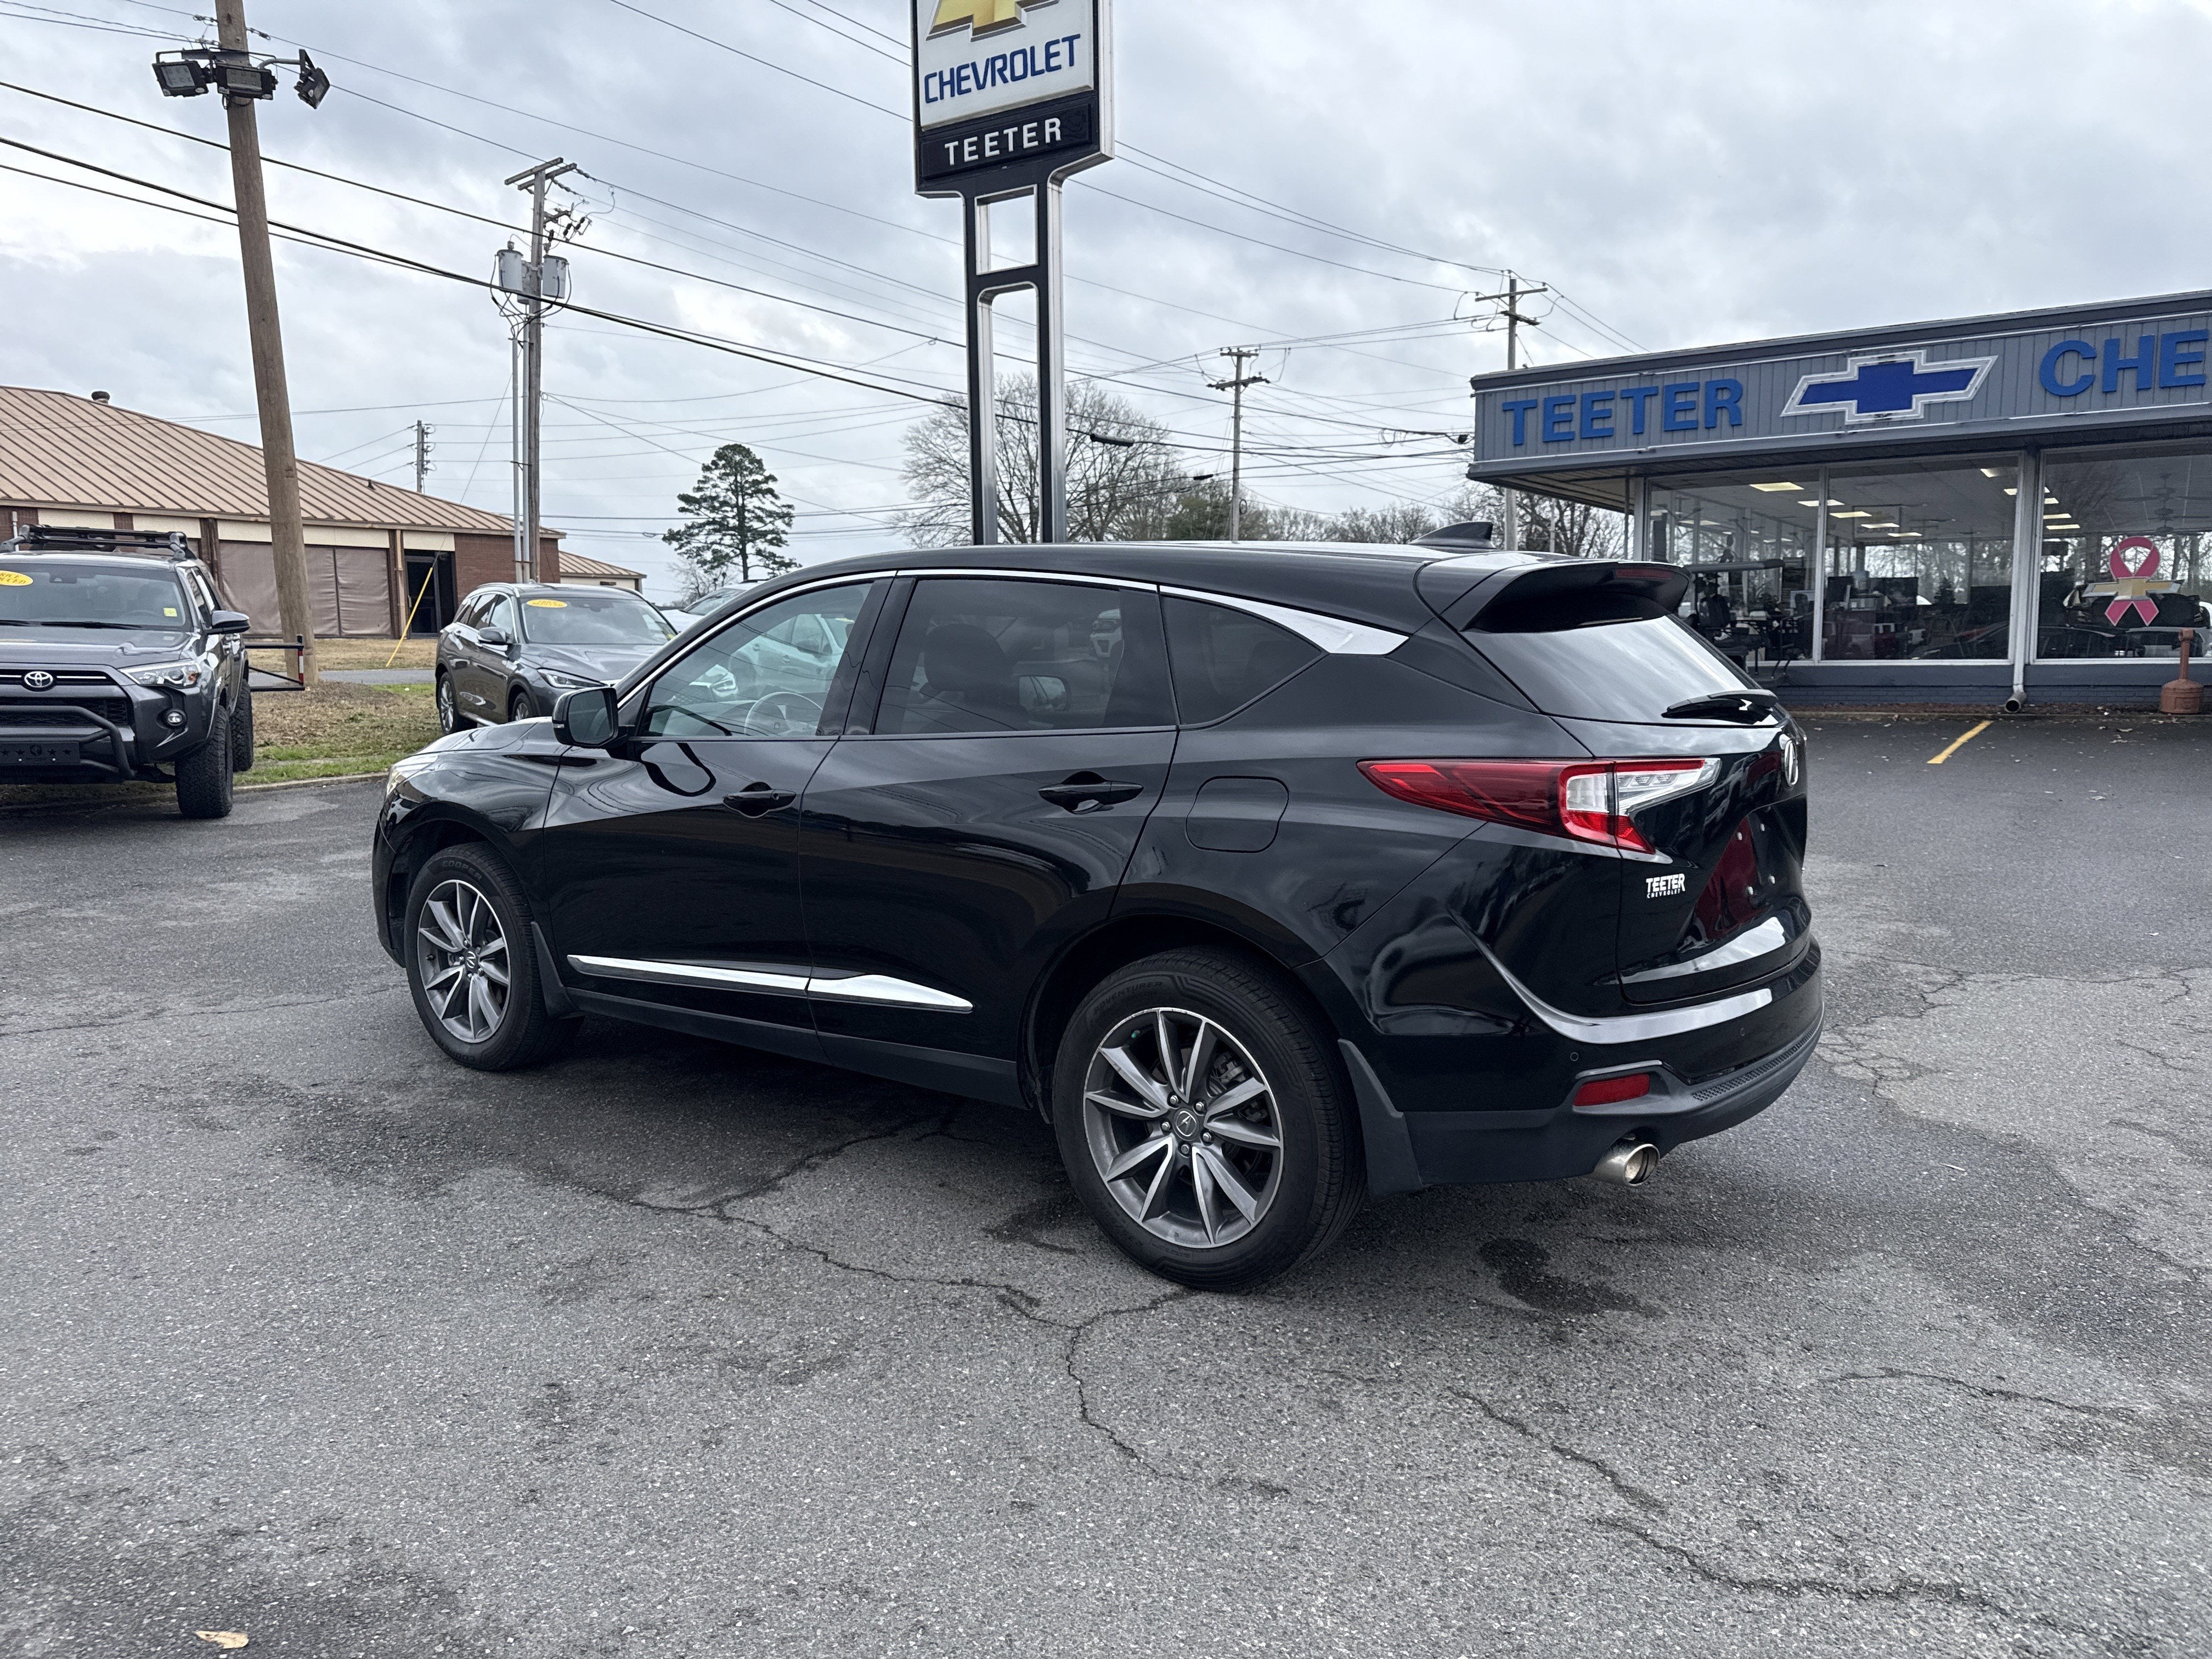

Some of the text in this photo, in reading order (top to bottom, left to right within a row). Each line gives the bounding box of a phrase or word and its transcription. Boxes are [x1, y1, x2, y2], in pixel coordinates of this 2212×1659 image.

[924, 33, 1081, 104] CHEVROLET
[944, 117, 1062, 166] TEETER
[2040, 329, 2209, 397] CHE
[1502, 378, 1743, 445] TEETER
[443, 860, 482, 880] COOPER
[1646, 873, 1685, 893] TEETER
[1647, 889, 1680, 898] CHEVROLET
